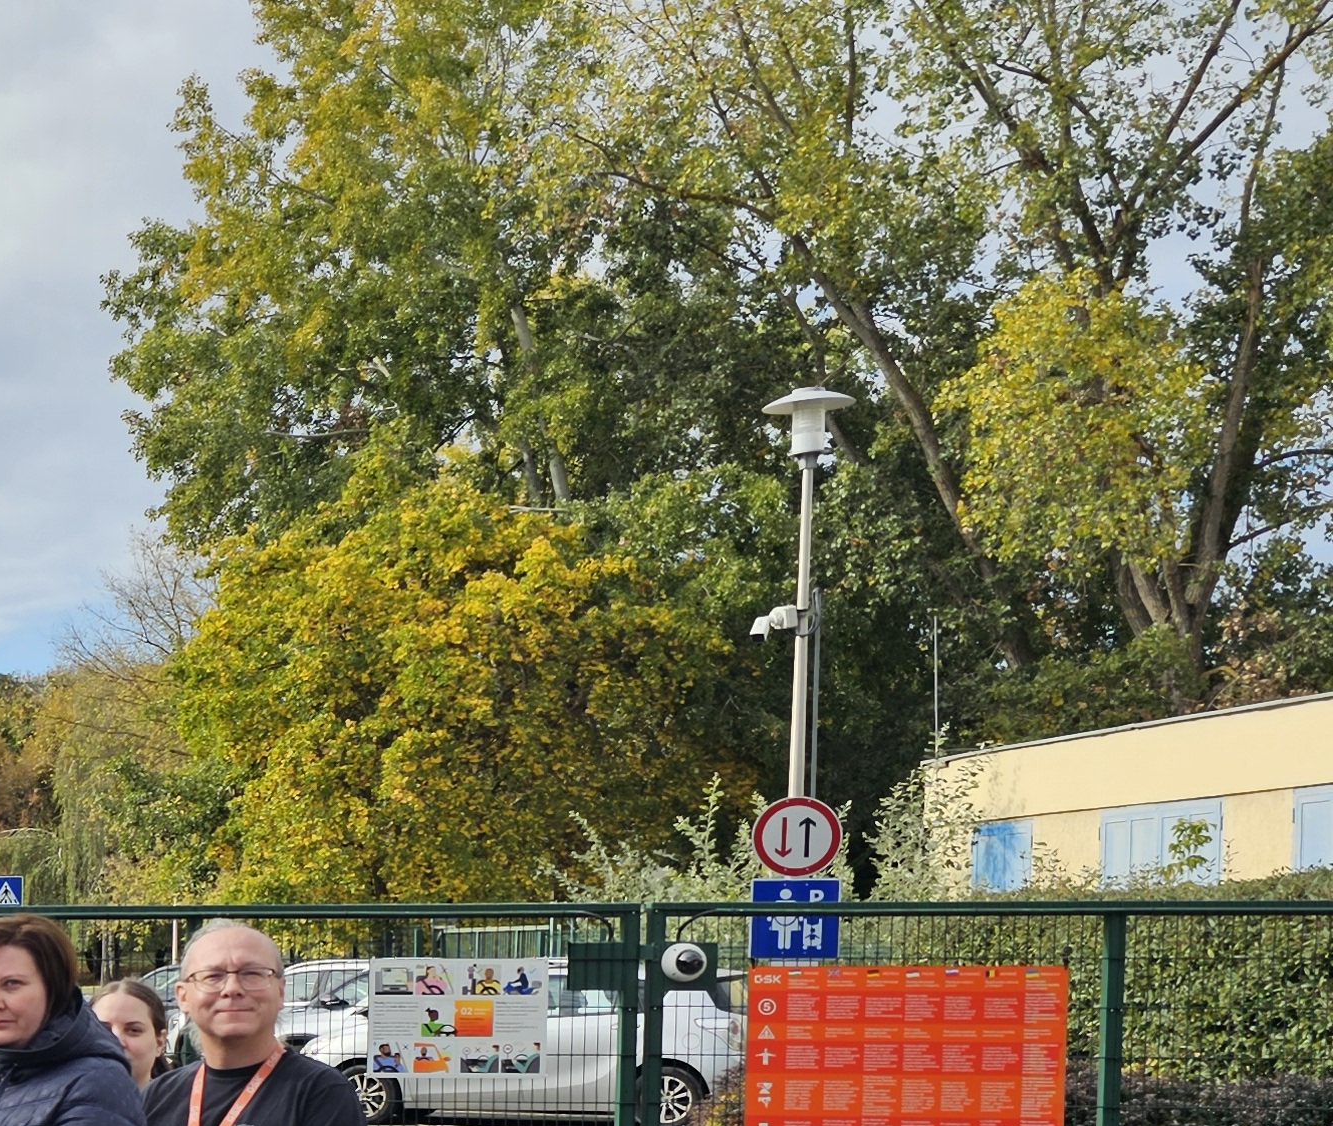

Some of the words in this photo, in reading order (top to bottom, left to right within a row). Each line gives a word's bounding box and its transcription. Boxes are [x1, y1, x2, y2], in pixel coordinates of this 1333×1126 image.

[810, 889, 824, 902] P
[754, 974, 781, 985] GSK
[460, 1007, 473, 1016] 02
